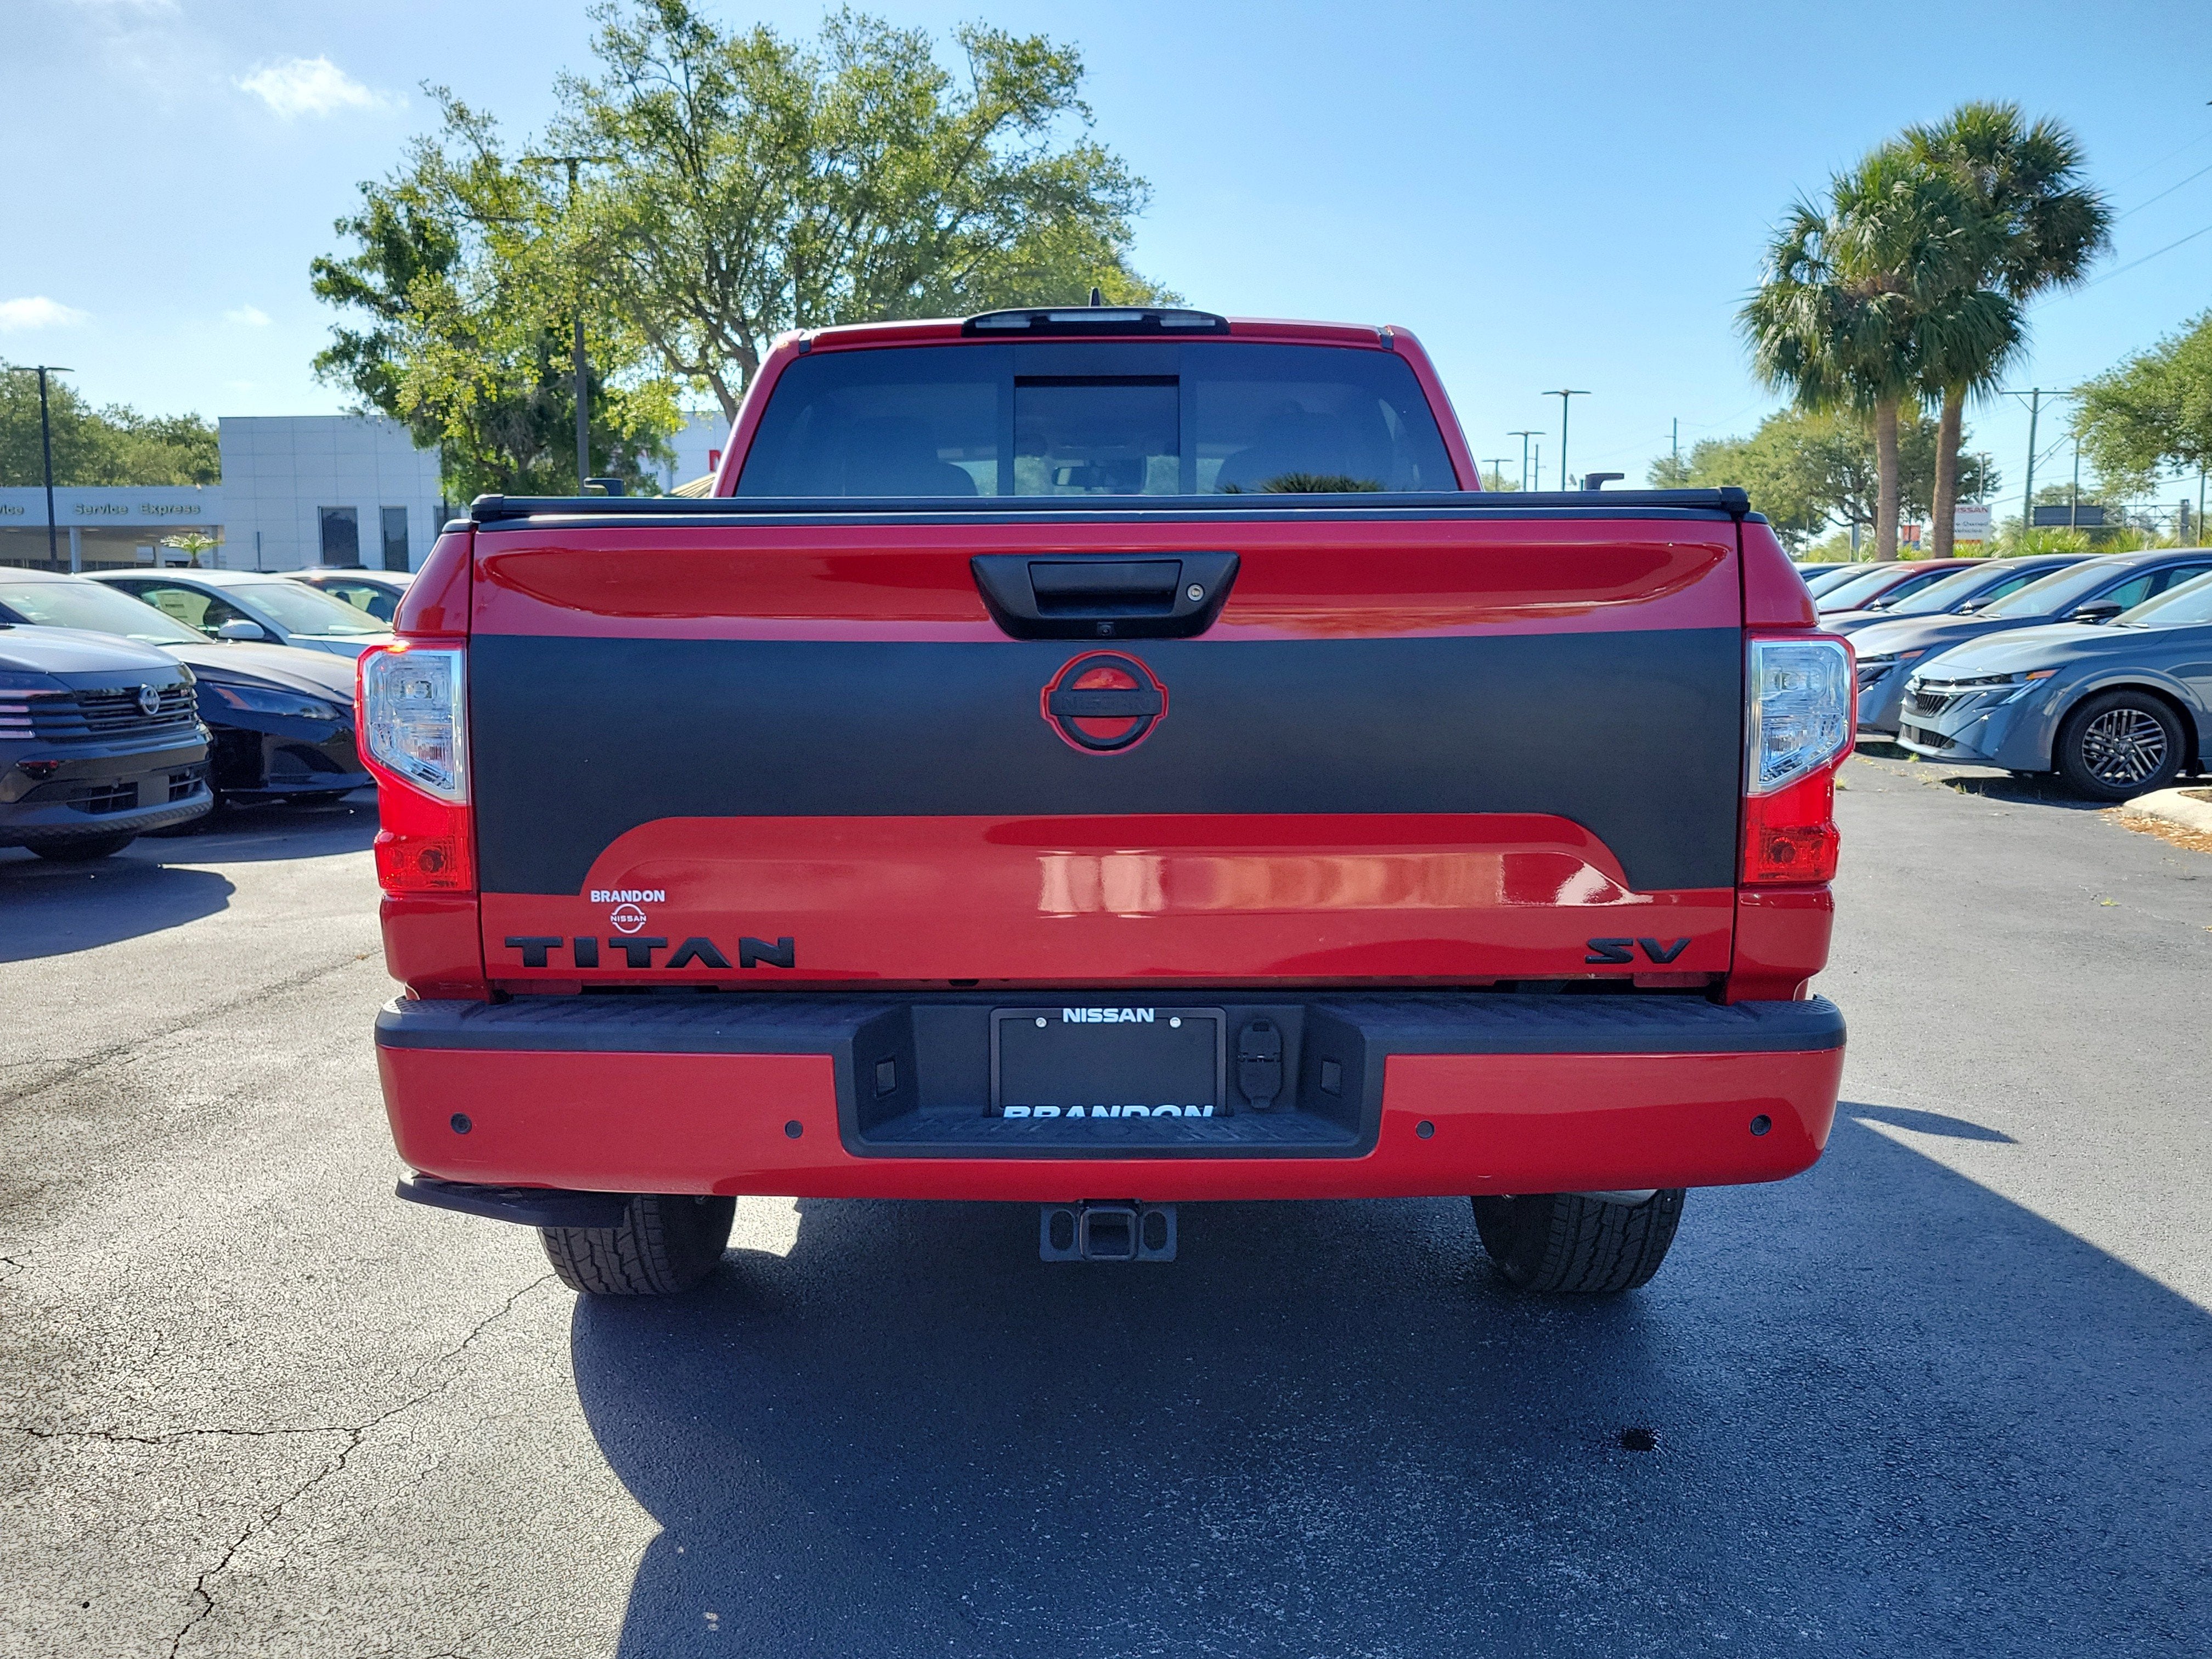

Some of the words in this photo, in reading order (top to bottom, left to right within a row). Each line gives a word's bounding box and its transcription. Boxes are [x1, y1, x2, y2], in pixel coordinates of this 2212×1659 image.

[75, 504, 128, 515] Service
[140, 504, 201, 516] Express
[590, 889, 665, 902] BRANDON
[505, 936, 795, 968] TITAN
[1585, 937, 1692, 964] SV
[1063, 1008, 1155, 1023] NISSAN
